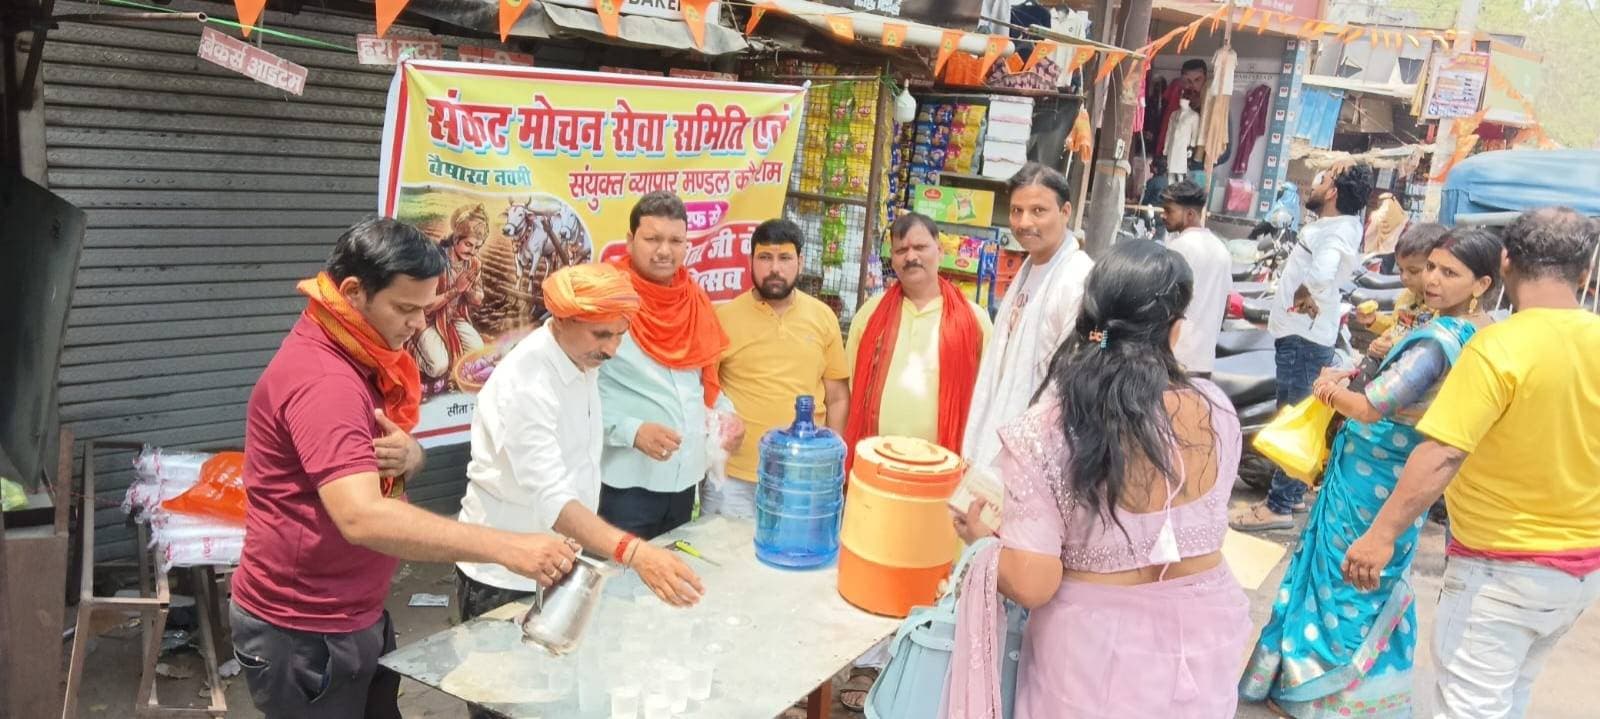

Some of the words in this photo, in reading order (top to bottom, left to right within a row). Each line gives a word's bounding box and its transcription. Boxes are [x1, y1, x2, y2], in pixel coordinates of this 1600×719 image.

[426, 89, 513, 150] संकट
[517, 95, 606, 152] मोचन
[611, 99, 668, 152] सेवा
[672, 103, 752, 151] समिति
[494, 164, 532, 186] नवमी
[569, 164, 626, 211] संयुक्त
[629, 169, 680, 195] व्यापार
[683, 170, 731, 195] मण्डल
[707, 203, 723, 227] से
[707, 227, 737, 259] जी
[447, 402, 468, 417] सीता
